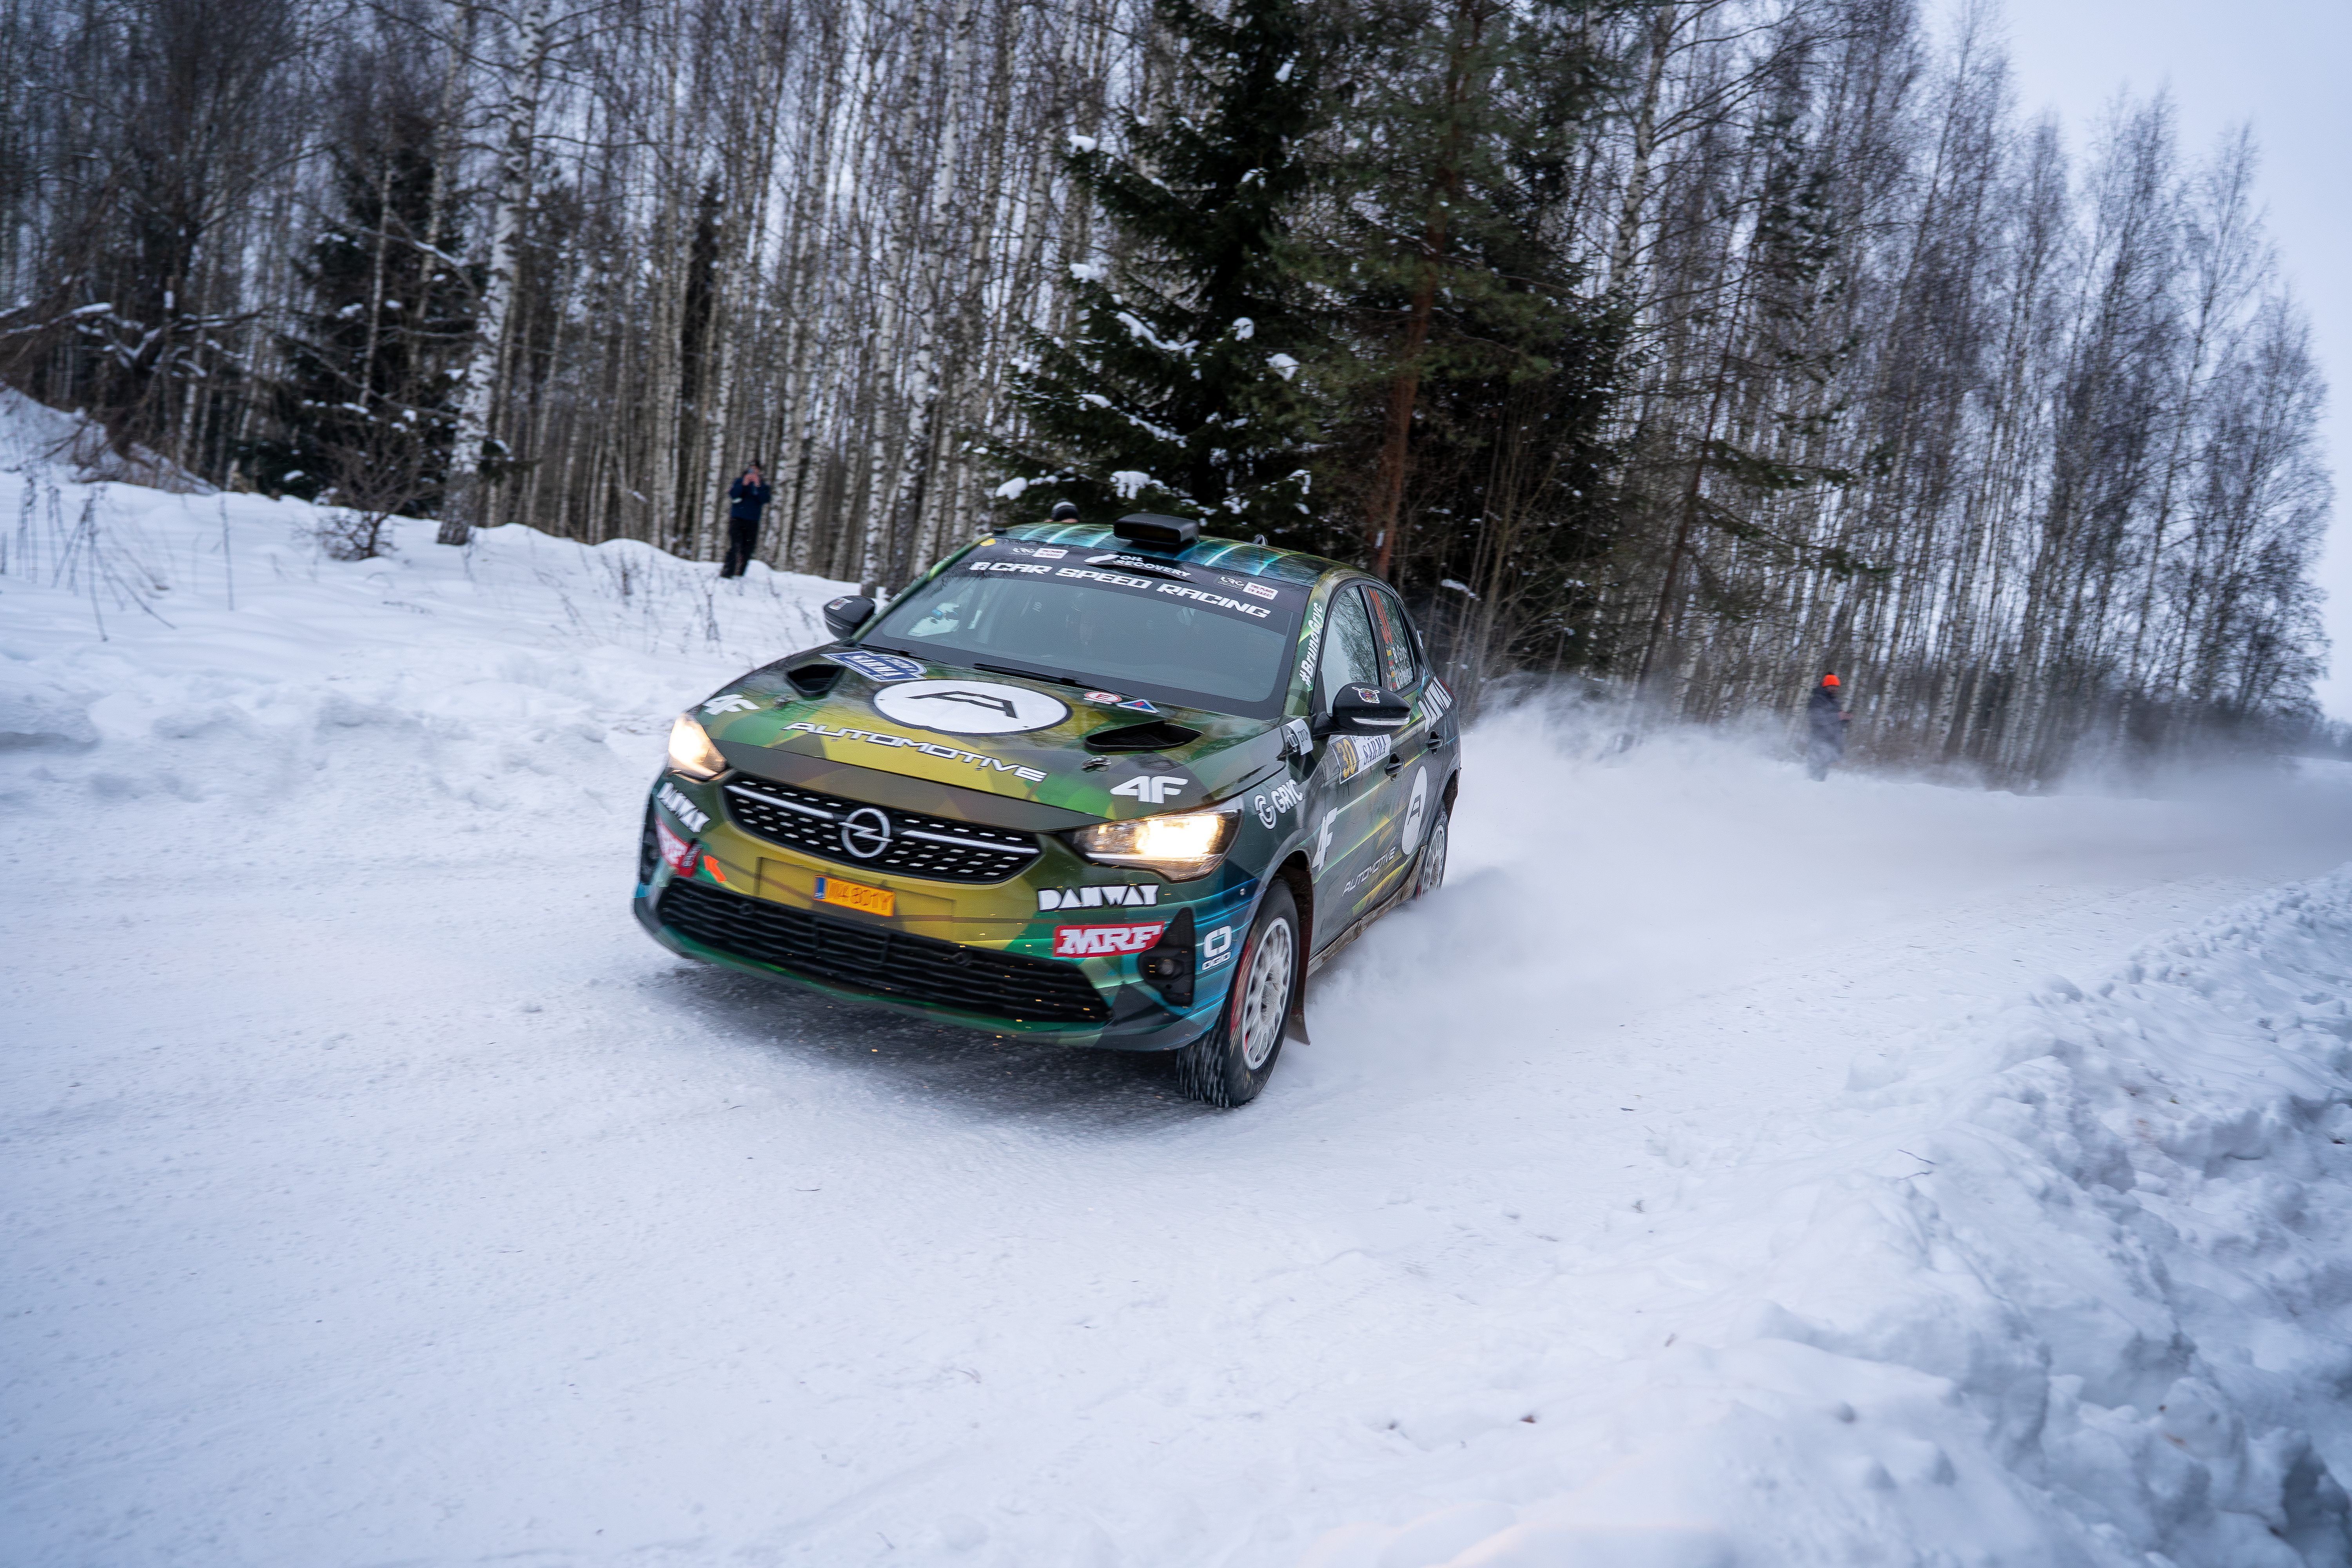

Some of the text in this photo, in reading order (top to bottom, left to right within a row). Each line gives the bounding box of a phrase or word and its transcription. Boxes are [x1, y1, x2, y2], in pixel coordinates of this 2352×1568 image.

[1115, 559, 1192, 577] RECOVERY
[1054, 567, 1154, 589] SPEED
[1156, 583, 1272, 619] RACING
[1299, 602, 1324, 688] #BrunoGryc
[779, 722, 1048, 783] AUTOMOTIVE
[1336, 739, 1357, 778] 30
[1109, 775, 1189, 804] 4F
[1270, 779, 1303, 814] GRYC
[1341, 846, 1397, 897] AUTOMOTIVE
[1038, 885, 1160, 910] DANWAY
[1056, 924, 1163, 954] MRF
